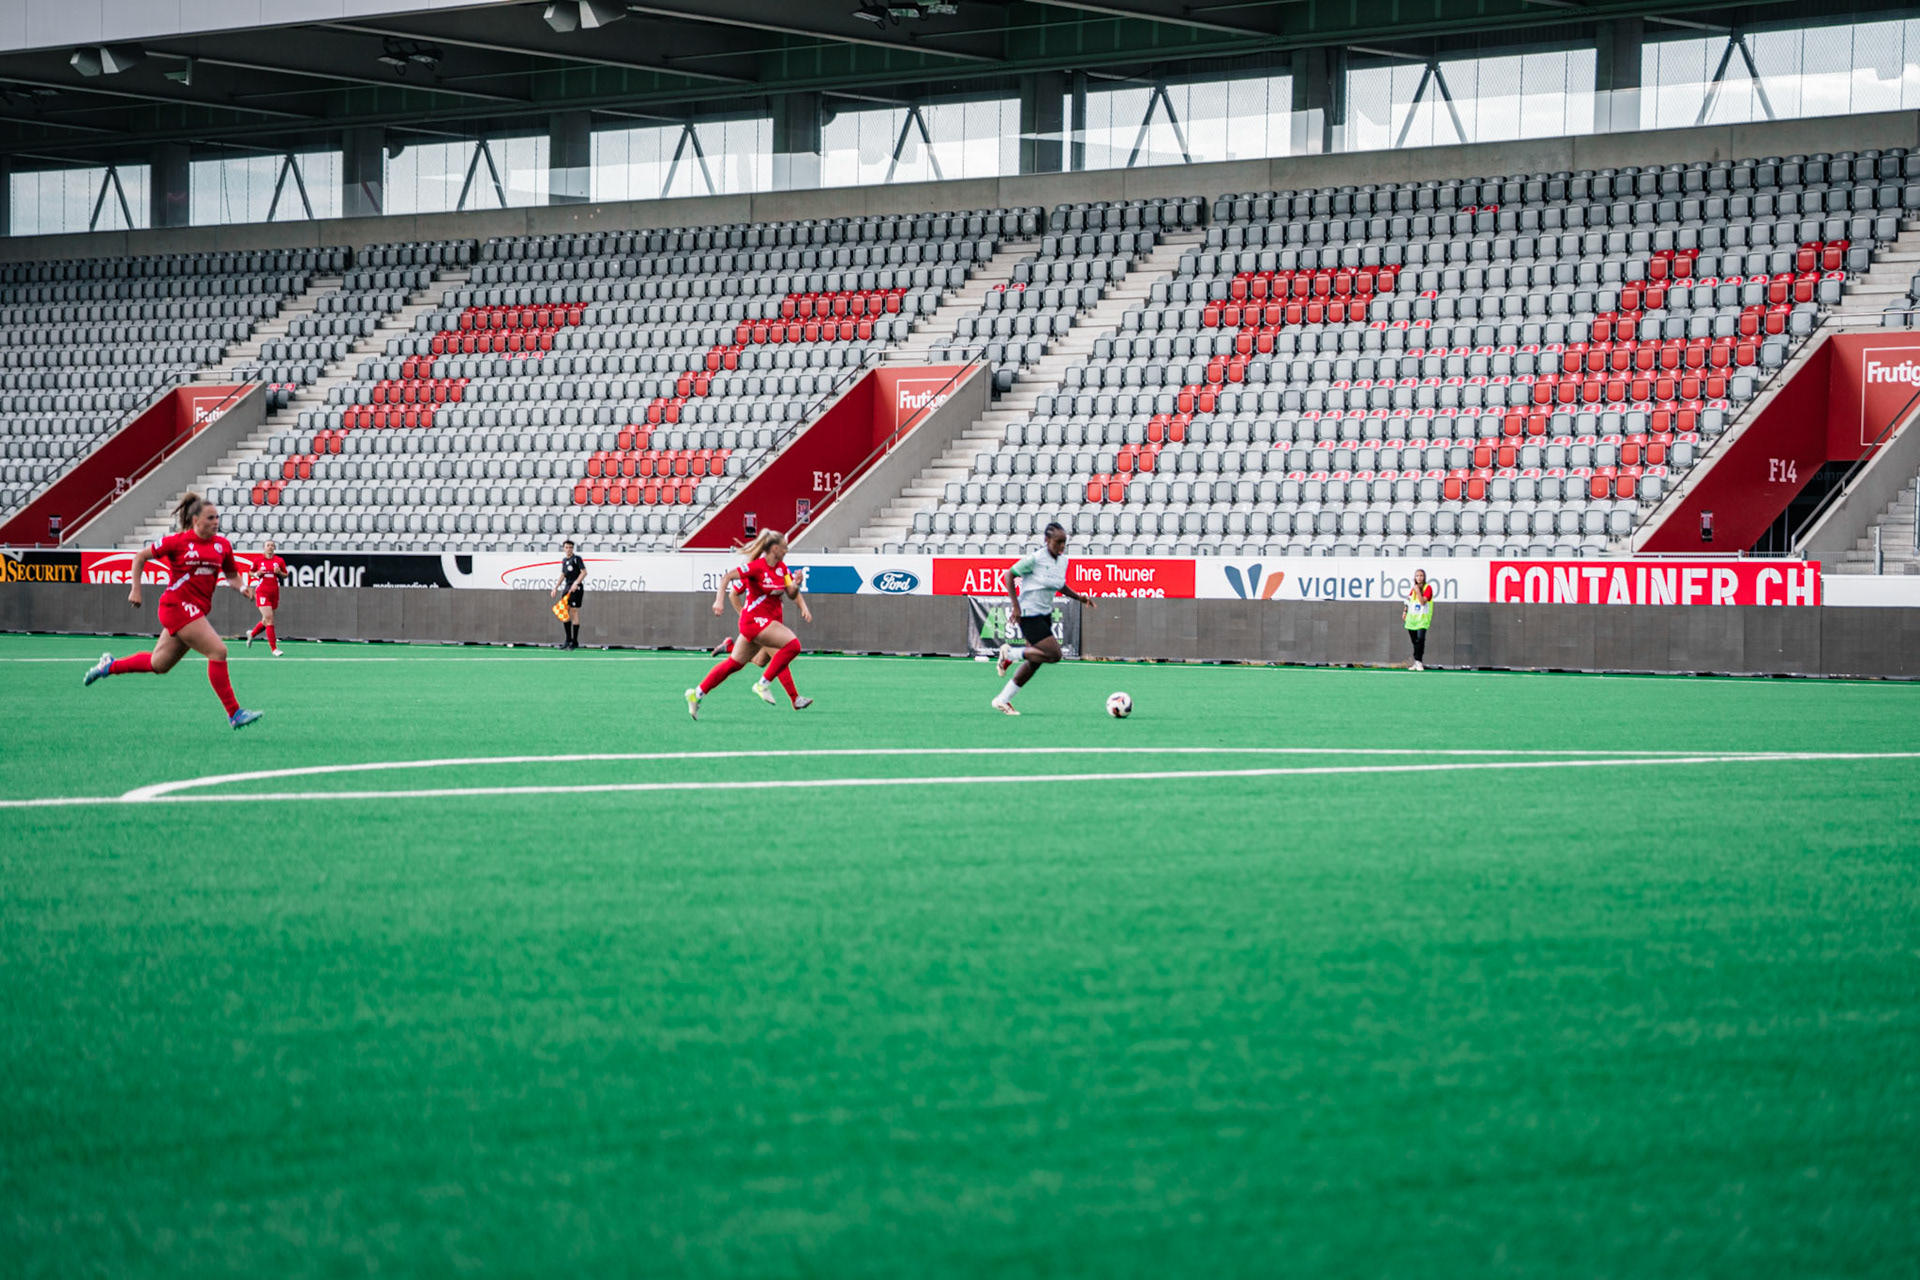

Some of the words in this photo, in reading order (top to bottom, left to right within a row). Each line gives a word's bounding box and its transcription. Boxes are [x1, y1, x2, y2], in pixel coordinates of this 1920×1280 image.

[812, 471, 842, 491] E13
[1769, 459, 1797, 482] F14
[7, 560, 78, 582] SECURITY
[880, 572, 910, 591] Ford
[961, 569, 1009, 592] AEK
[1075, 564, 1102, 582] Ihre
[1105, 564, 1155, 582] Thuner
[1298, 577, 1374, 600] vigier
[1381, 571, 1458, 599] beon
[1496, 566, 1736, 605] CONTAINER
